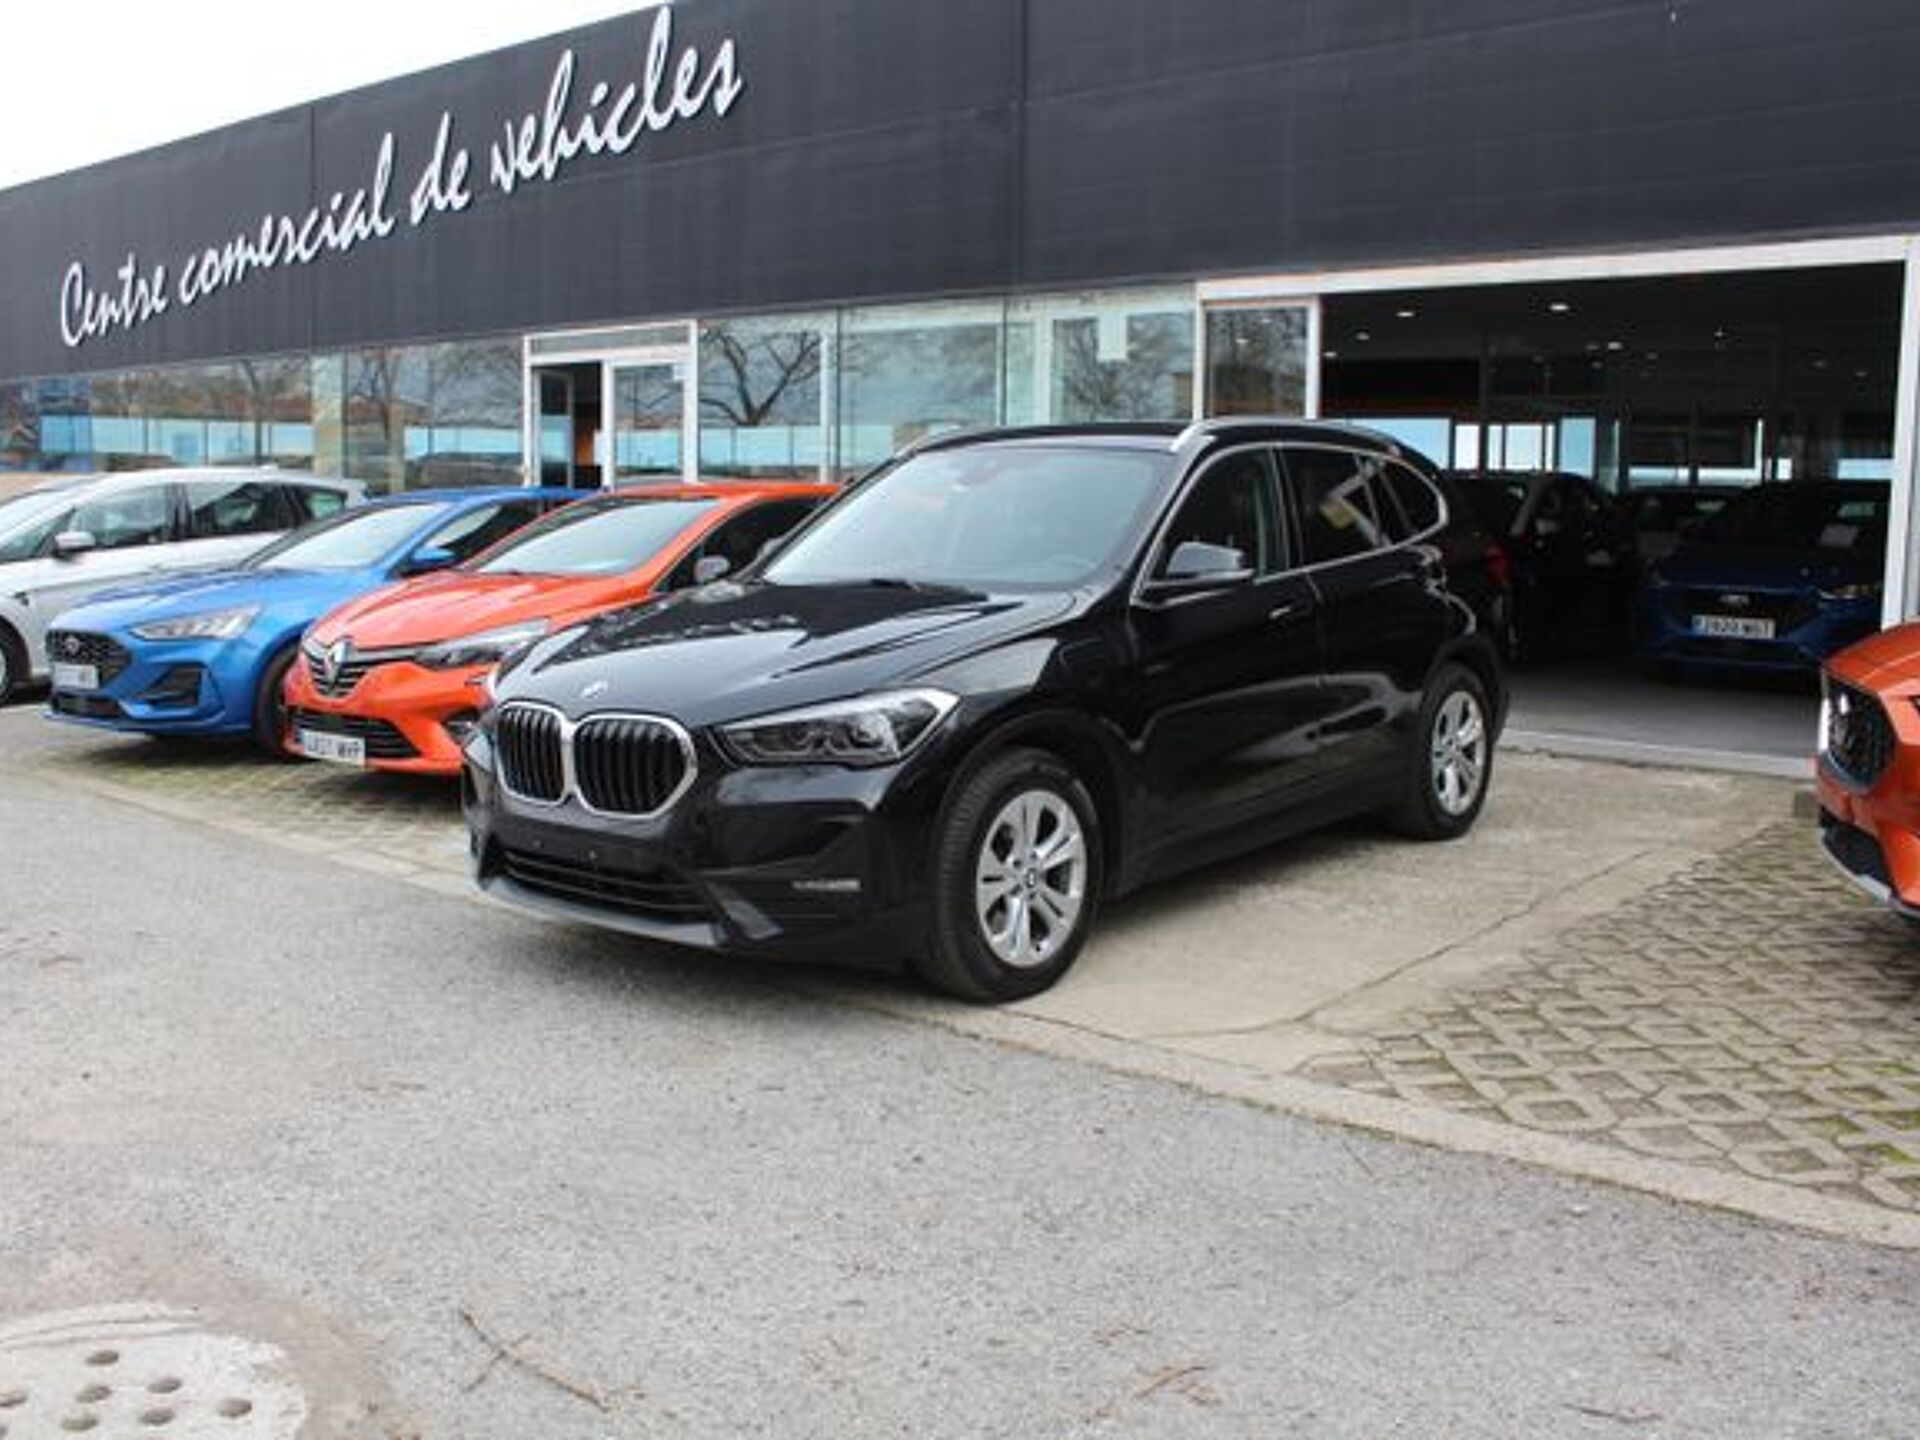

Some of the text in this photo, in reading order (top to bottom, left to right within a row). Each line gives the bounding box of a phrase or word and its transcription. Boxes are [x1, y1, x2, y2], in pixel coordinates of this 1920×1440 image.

[60, 5, 742, 347] Centre comercial de vehicles
